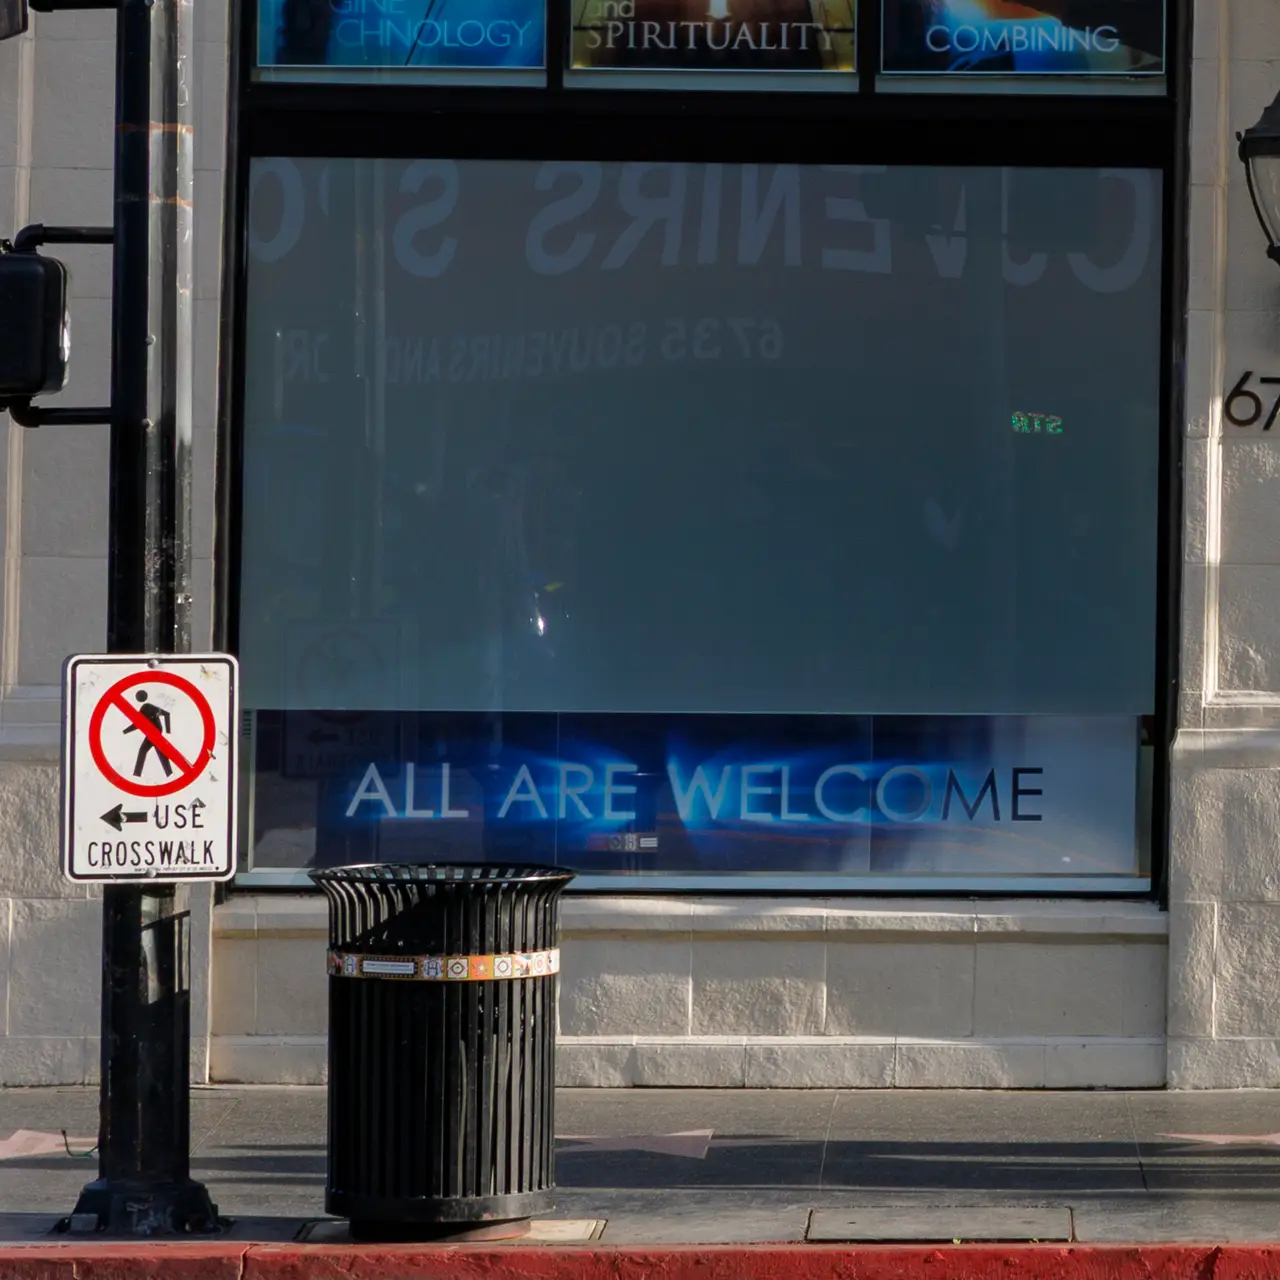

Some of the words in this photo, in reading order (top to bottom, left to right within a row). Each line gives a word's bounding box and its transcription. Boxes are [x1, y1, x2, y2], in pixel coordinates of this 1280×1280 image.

[585, 20, 843, 51] SPIRITUALITY
[925, 24, 1120, 53] COMBINING
[345, 763, 469, 819] ALL
[497, 763, 637, 820] ARE
[667, 764, 1043, 821] WELCOME
[155, 804, 205, 829] USE
[88, 840, 214, 867] CROSSWALK
